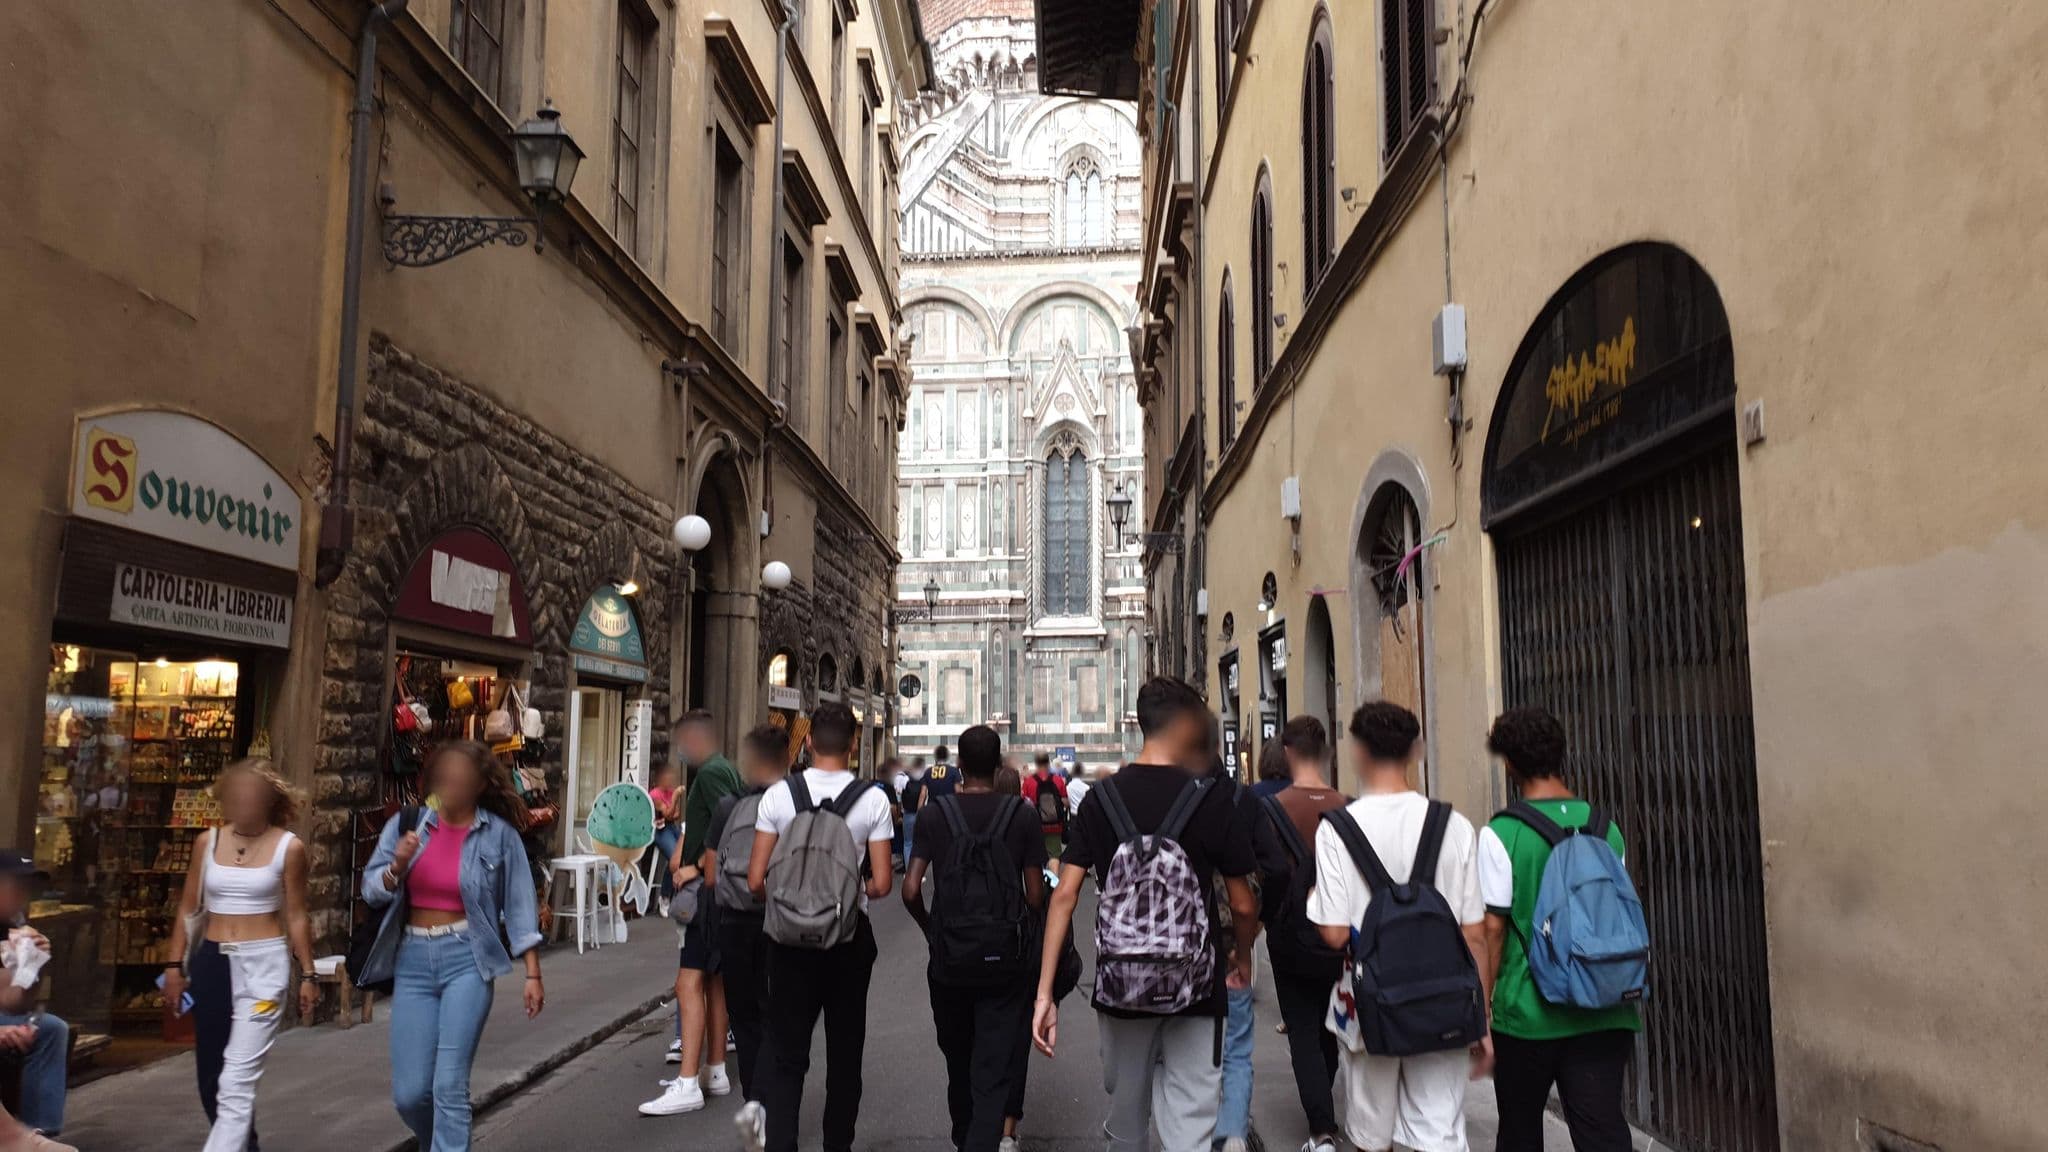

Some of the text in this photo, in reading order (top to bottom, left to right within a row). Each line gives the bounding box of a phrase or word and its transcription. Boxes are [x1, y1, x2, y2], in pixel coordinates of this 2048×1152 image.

[88, 438, 292, 546] Souvenir
[131, 603, 275, 640] CARTA ARTISTICA FIORENTINA
